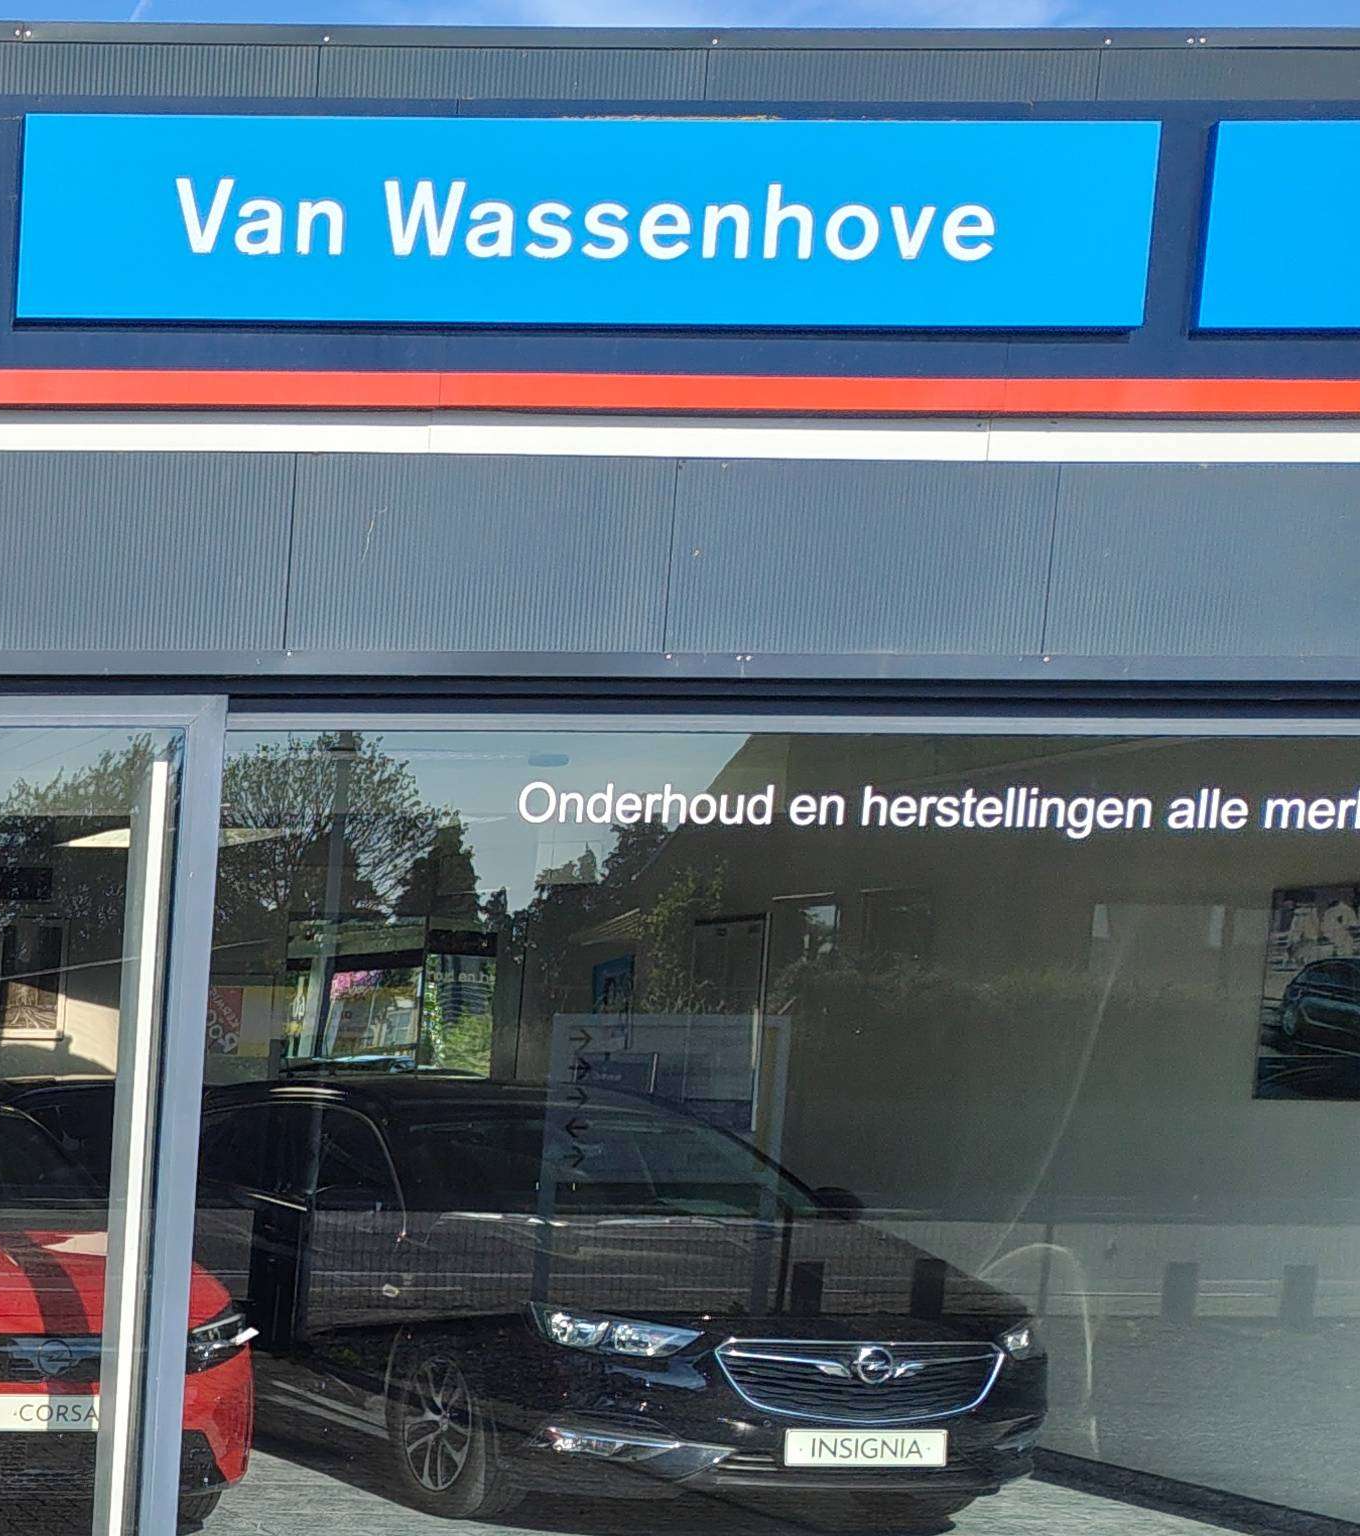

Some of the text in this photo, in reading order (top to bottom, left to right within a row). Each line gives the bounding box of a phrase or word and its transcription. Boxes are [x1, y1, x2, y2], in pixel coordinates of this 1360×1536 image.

[175, 177, 996, 262] Van Wassenhove
[518, 780, 1360, 839] Onderhoud en herstellingen alle mer
[18, 1403, 101, 1423] CORSA
[810, 1436, 924, 1460] INSIGNIA
